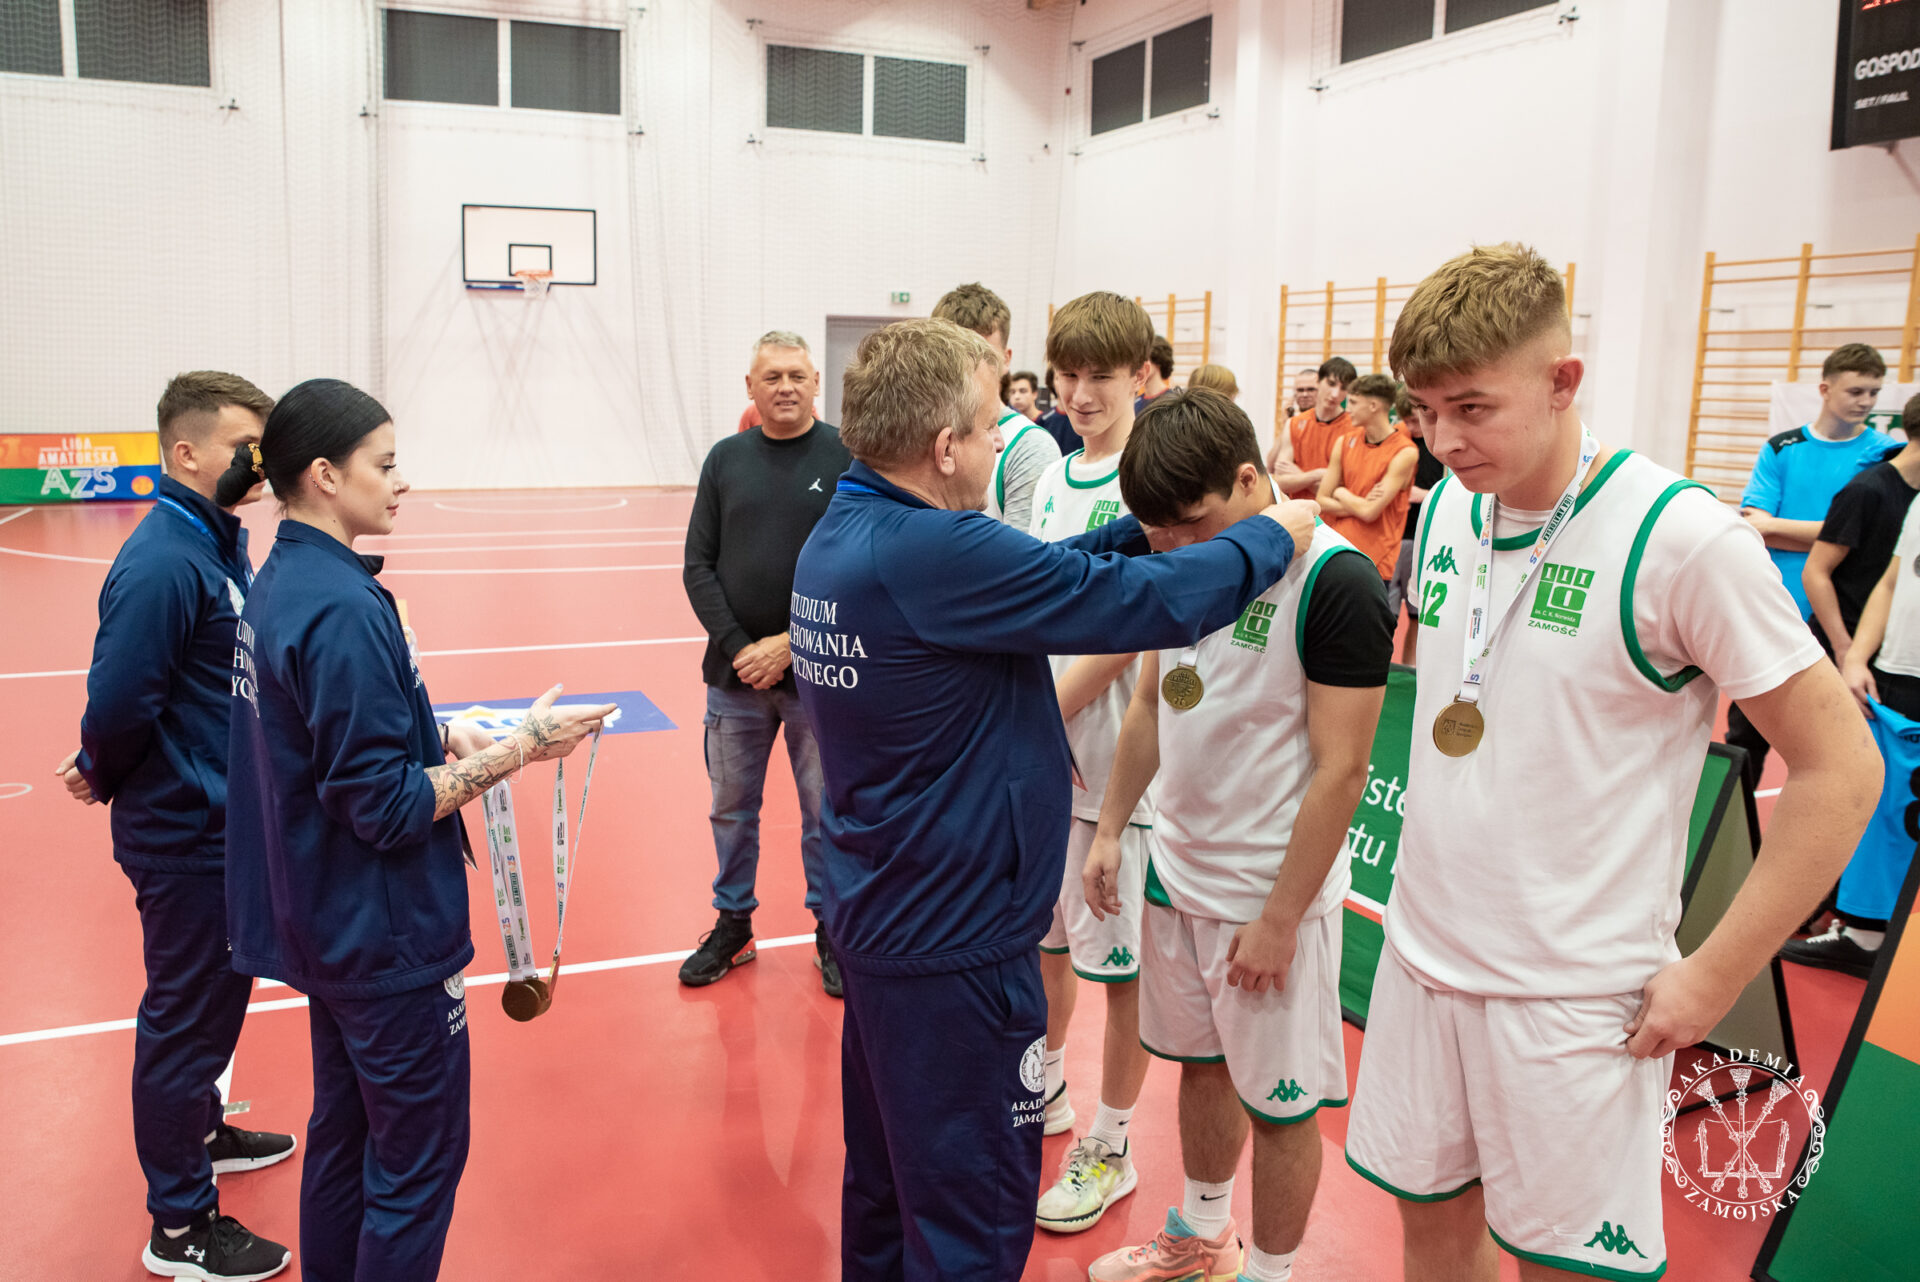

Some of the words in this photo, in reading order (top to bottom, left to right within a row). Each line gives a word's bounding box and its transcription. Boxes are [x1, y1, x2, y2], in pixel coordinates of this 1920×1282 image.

[61, 437, 92, 451] LIGA
[38, 451, 118, 466] AMATORSKA
[40, 466, 117, 499] AZS
[1418, 580, 1448, 628] 12
[1528, 619, 1577, 637] ZAMOŚĆ
